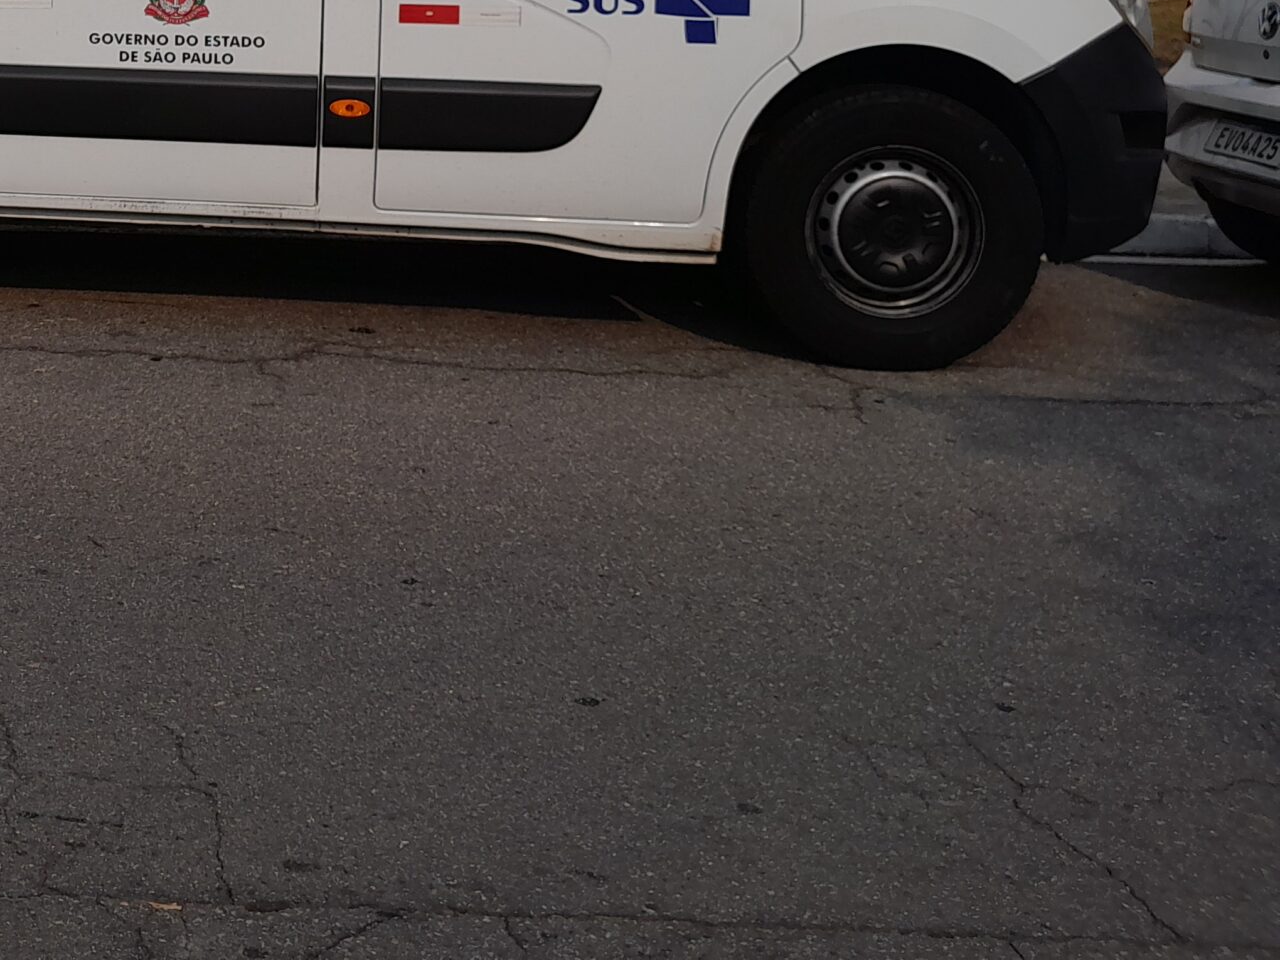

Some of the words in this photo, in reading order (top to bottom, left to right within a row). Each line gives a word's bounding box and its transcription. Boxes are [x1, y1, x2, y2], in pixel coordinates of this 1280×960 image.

[89, 32, 169, 46] GOVERNO
[174, 35, 199, 47] DO
[204, 36, 266, 49] ESTADO
[119, 50, 138, 63] DE
[144, 48, 176, 64] SÃO
[182, 52, 234, 65] PAULO
